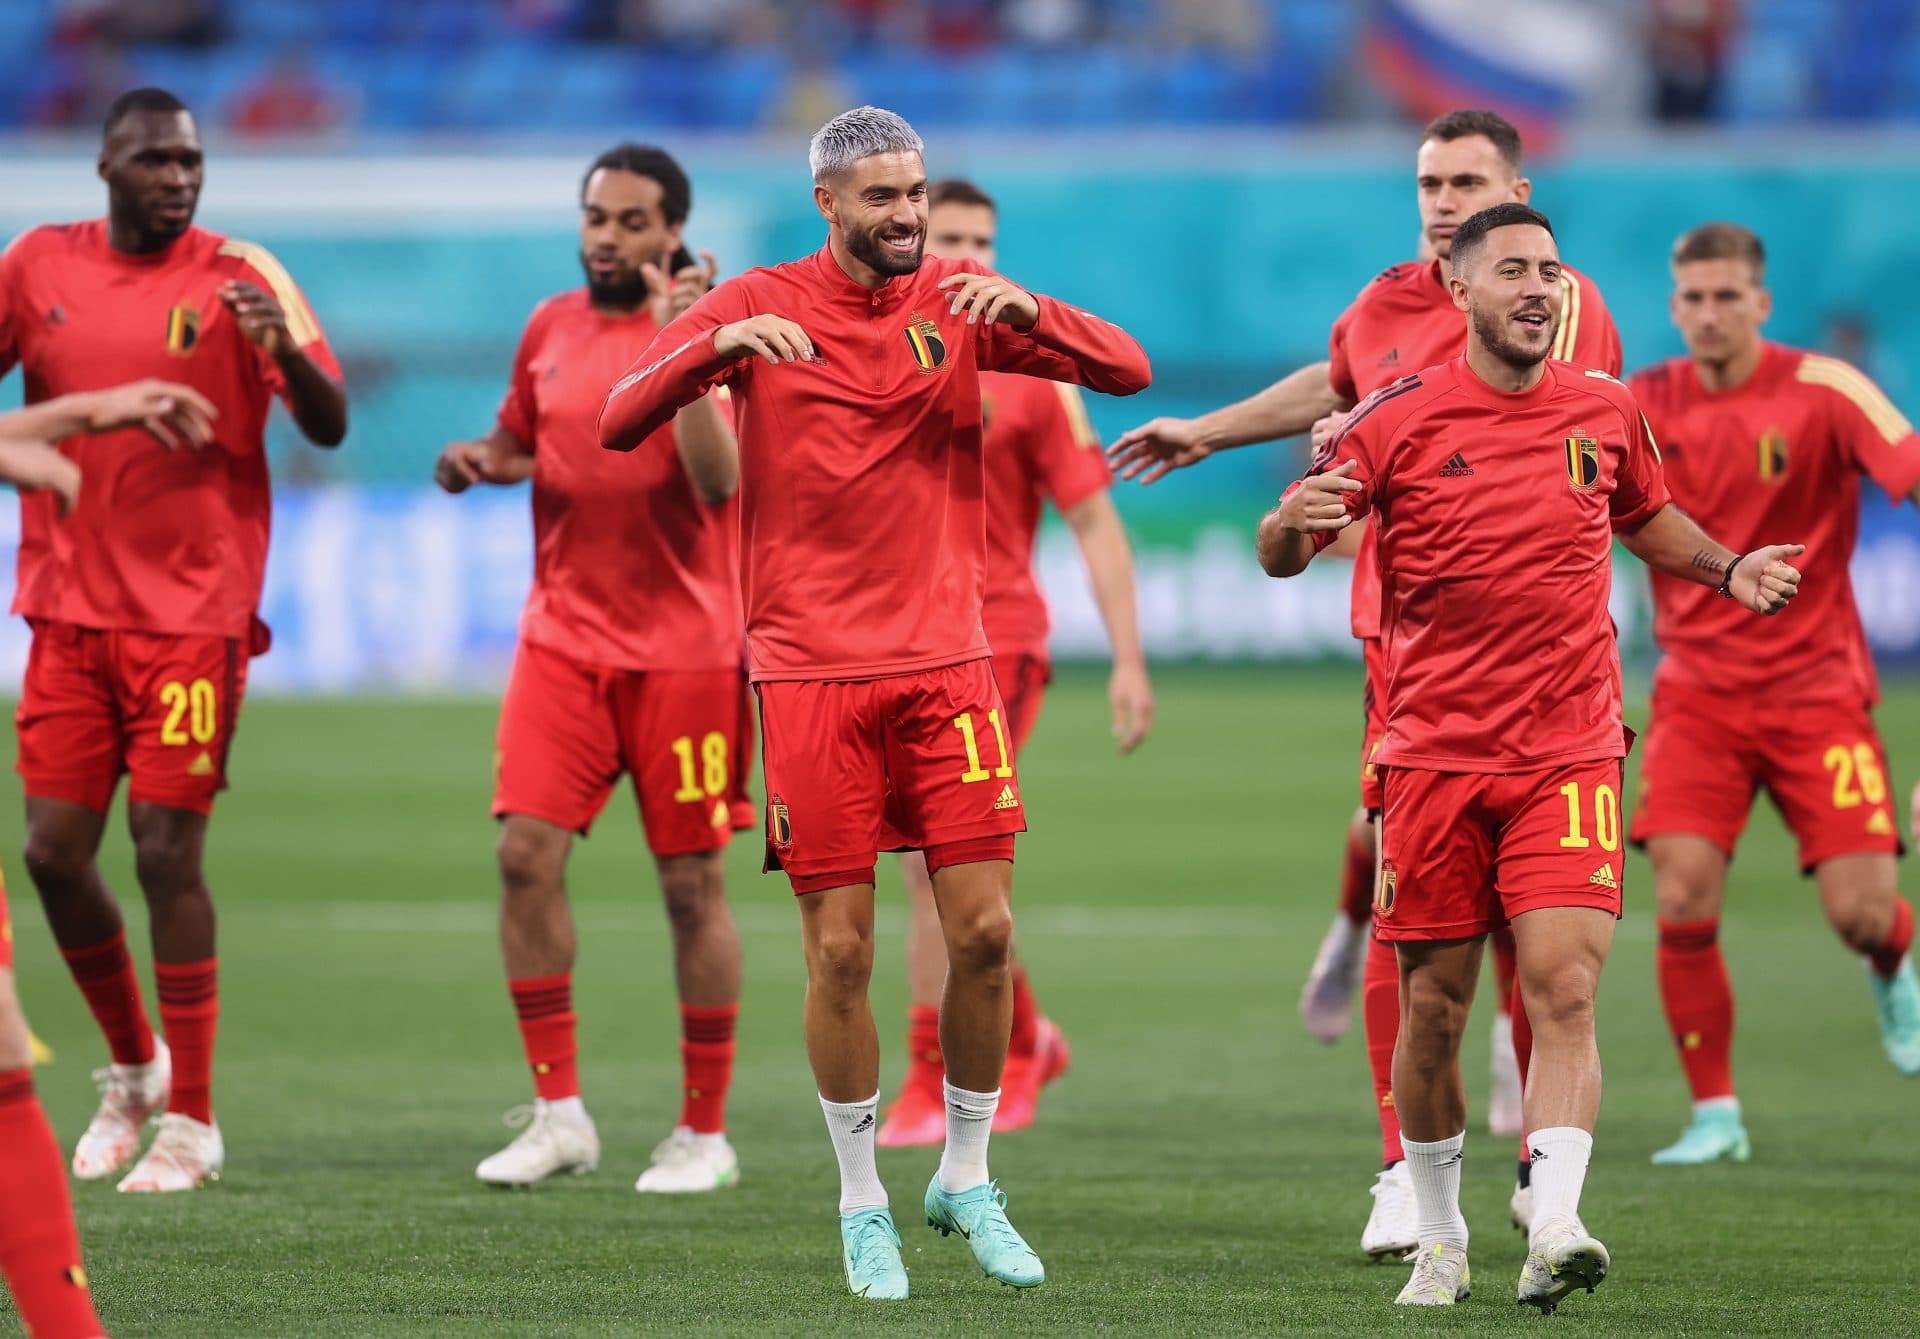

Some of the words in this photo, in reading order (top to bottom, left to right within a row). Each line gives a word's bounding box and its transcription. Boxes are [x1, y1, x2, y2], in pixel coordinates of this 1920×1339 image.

[1438, 468, 1474, 477] adidas
[160, 678, 216, 745] 20
[953, 708, 1013, 783] 11
[672, 731, 728, 803] 18
[1824, 742, 1886, 810] 26
[1559, 782, 1618, 852] 10
[1589, 875, 1618, 889] adidas
